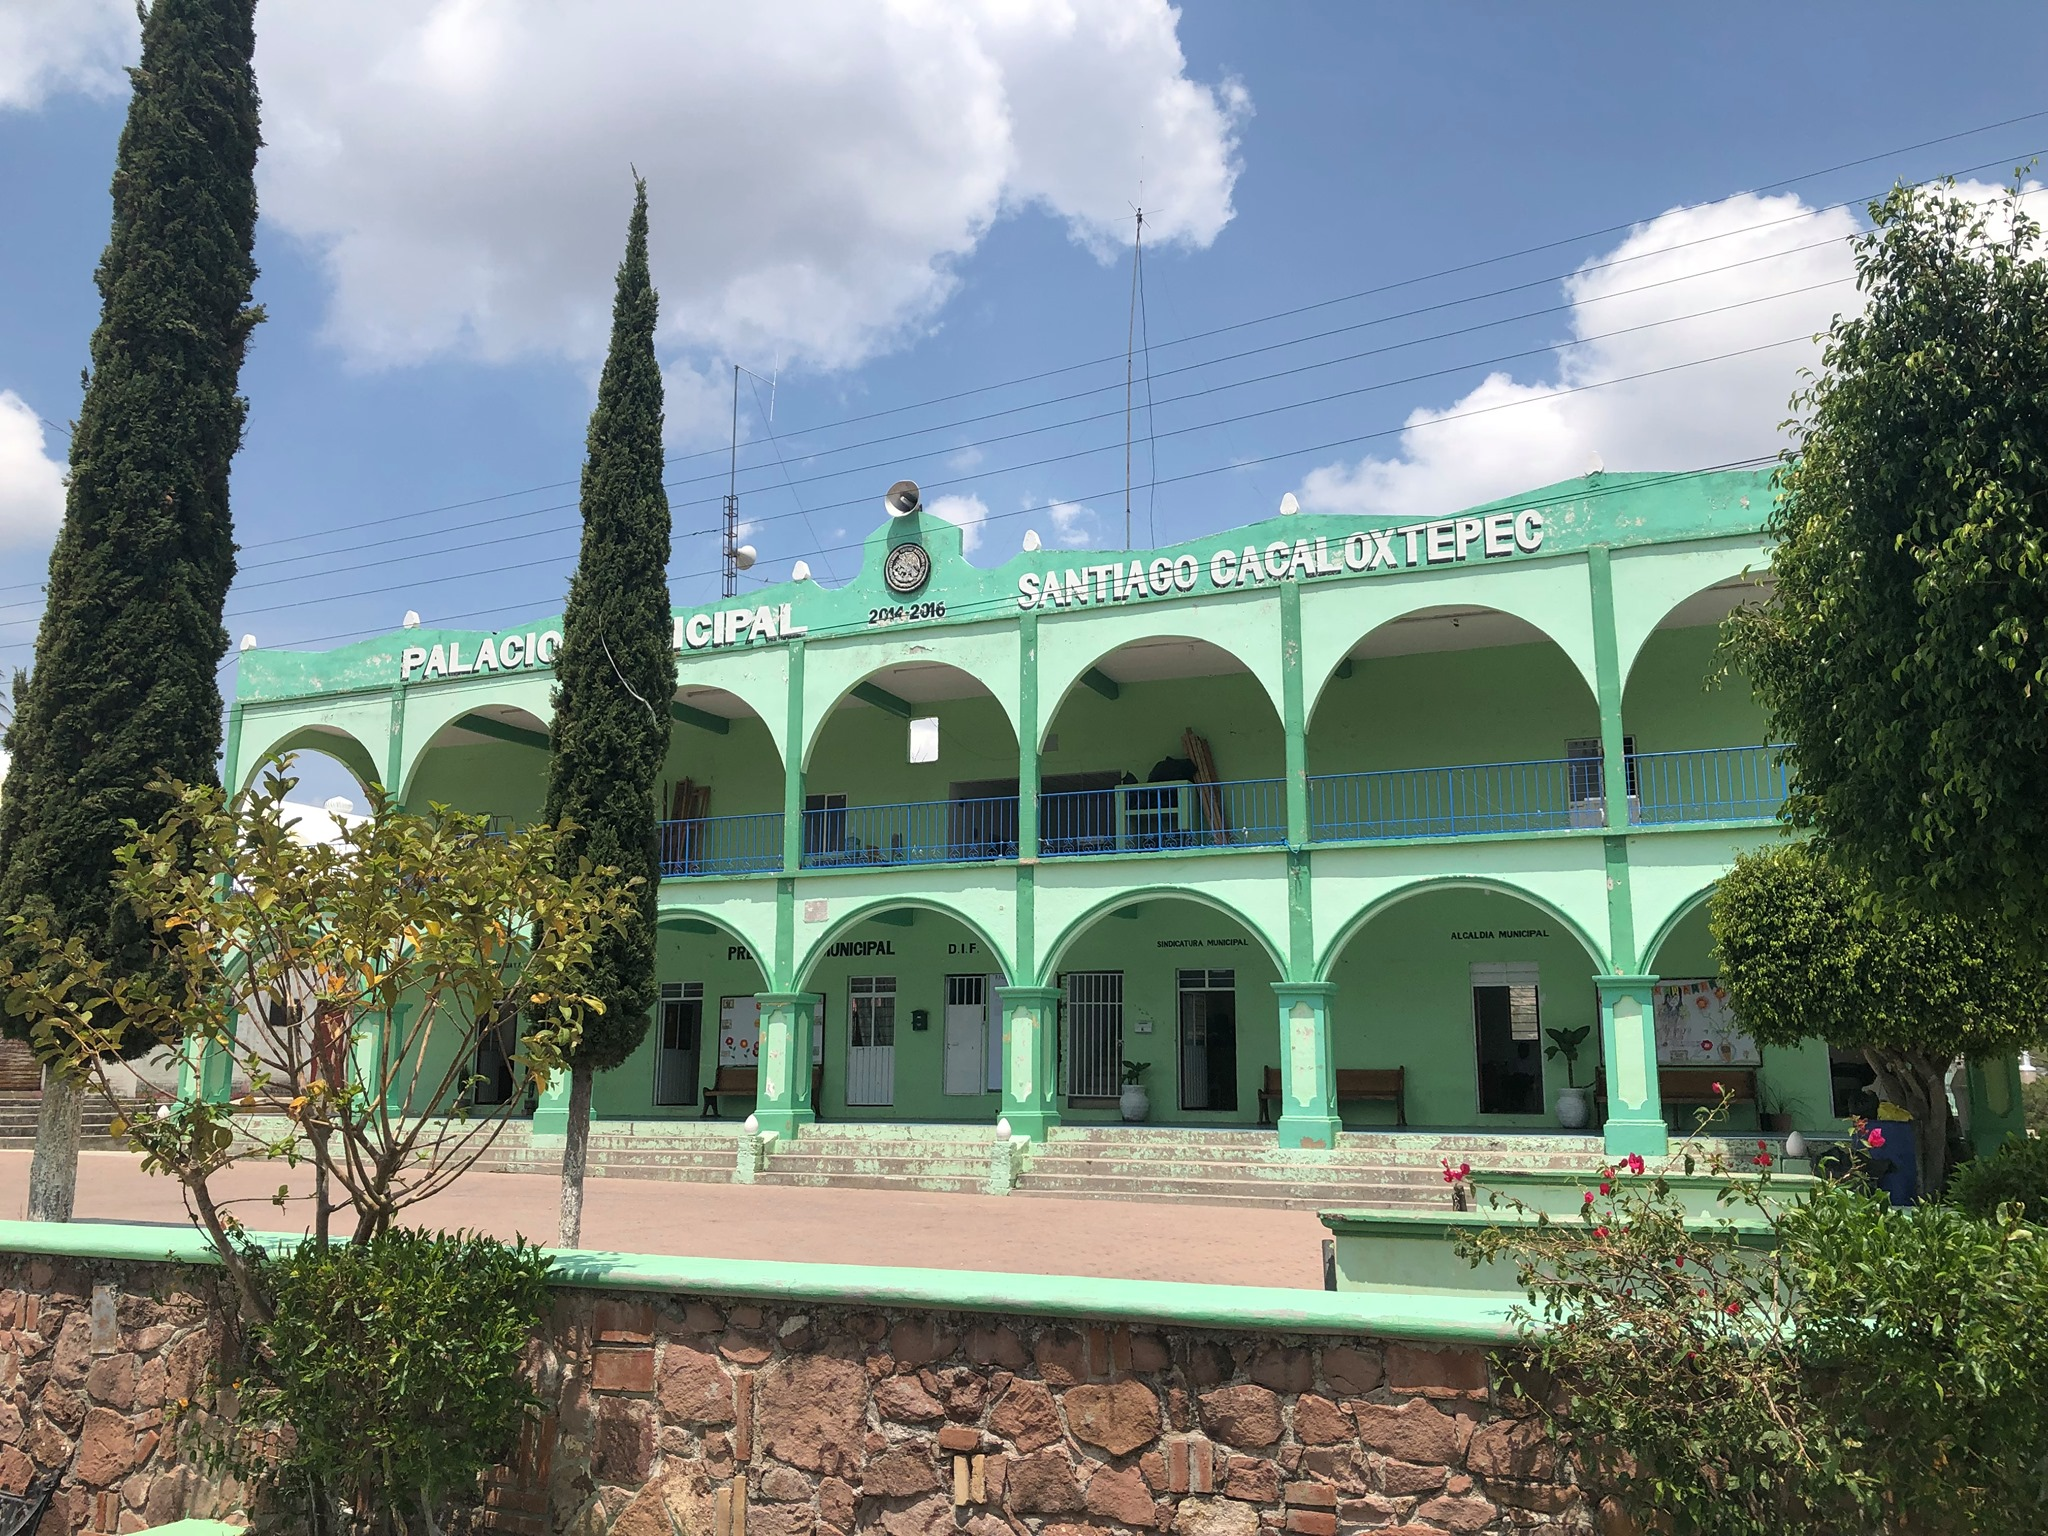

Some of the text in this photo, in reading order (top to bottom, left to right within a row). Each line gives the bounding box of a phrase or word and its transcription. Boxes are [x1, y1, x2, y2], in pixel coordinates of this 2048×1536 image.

[1017, 508, 1545, 610] SANTIAGO CACALOXTEPEC
[868, 601, 946, 624] 2014-2016
[400, 602, 808, 681] PALACIO ICIPAL
[1156, 938, 1248, 948] SINDICATURA MUNICIPAL
[1450, 929, 1550, 940] ALCALDIA MUNICIPAL
[948, 943, 980, 954] D.I.F.
